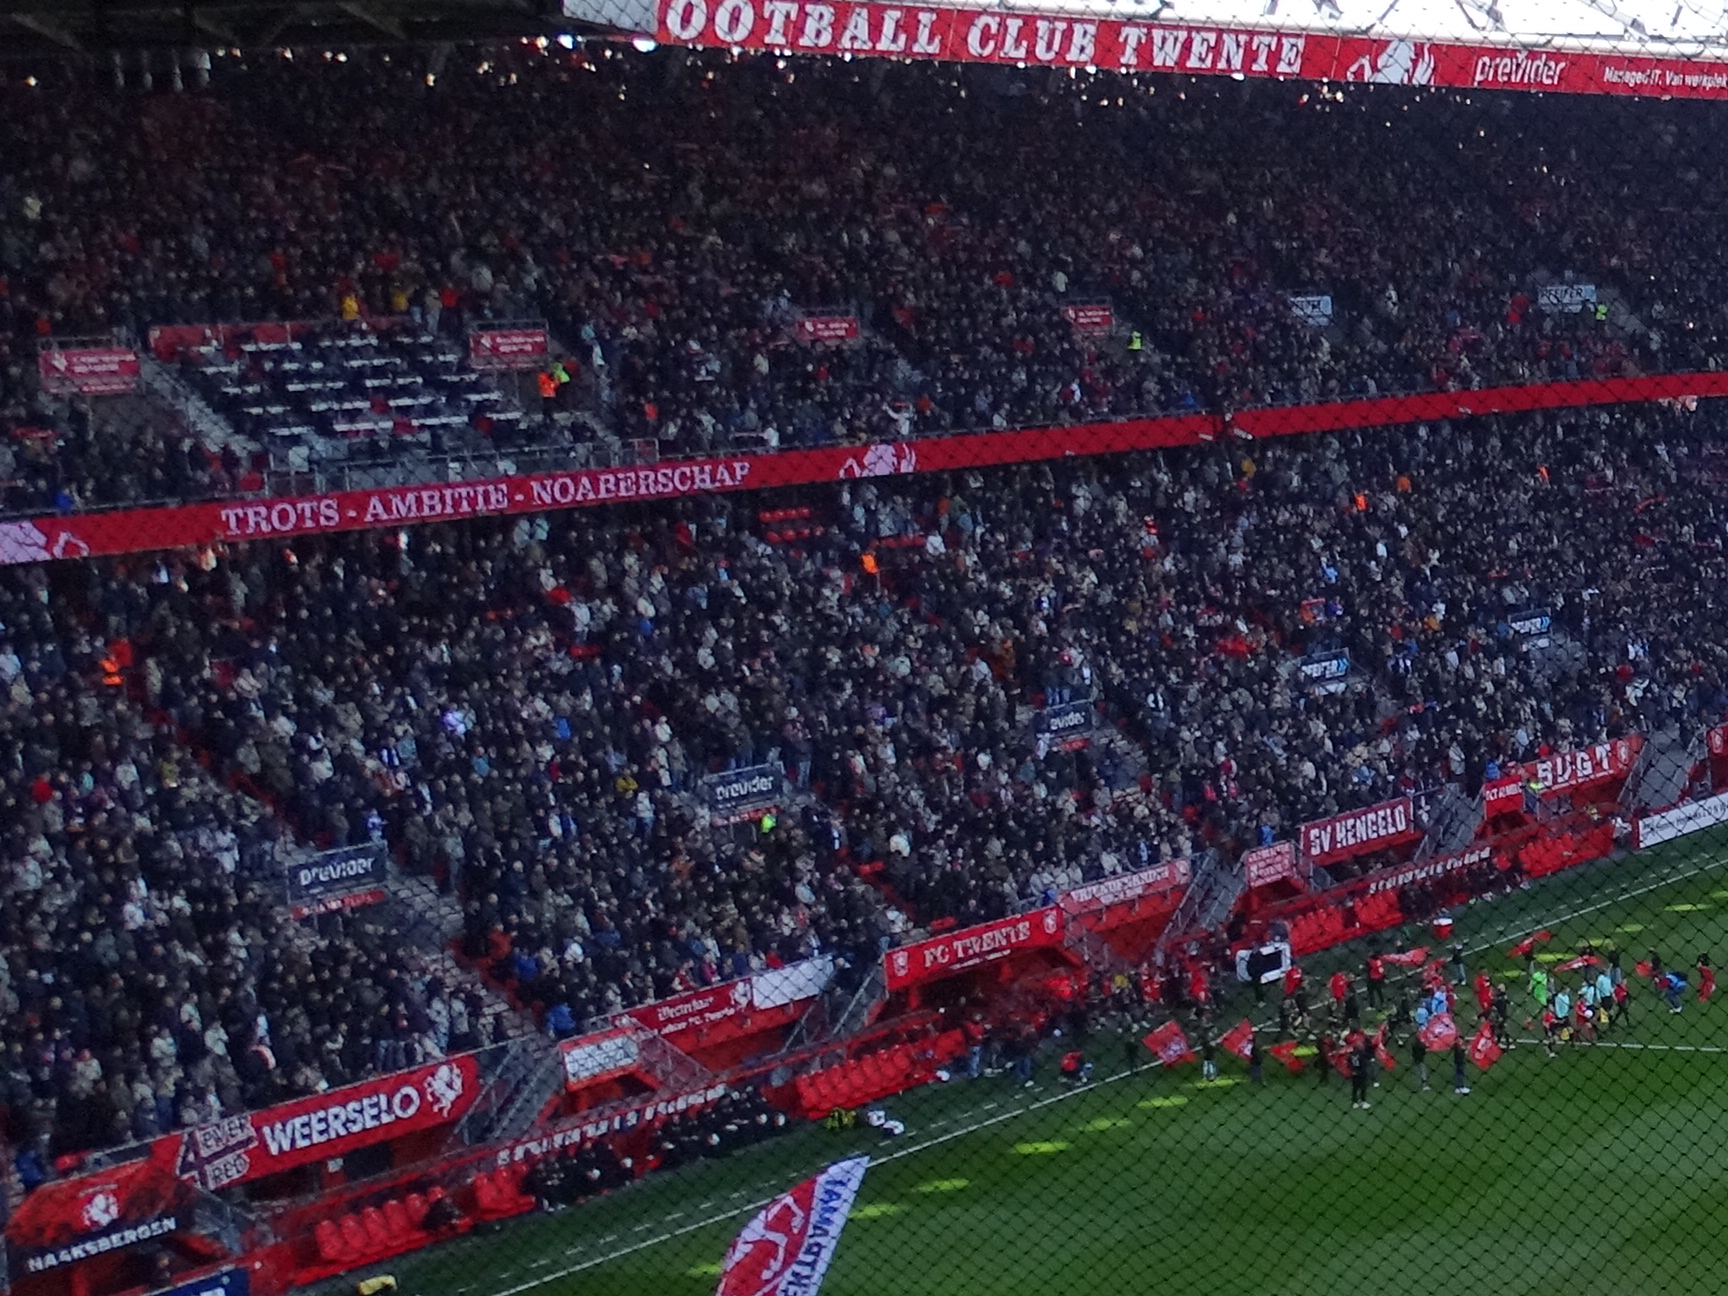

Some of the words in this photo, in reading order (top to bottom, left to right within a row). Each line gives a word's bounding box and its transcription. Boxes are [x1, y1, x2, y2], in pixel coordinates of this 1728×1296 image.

[967, 15, 1097, 61] CLUB
[1119, 26, 1305, 73] TWENTE
[221, 497, 340, 536] TROTS
[364, 482, 508, 523] AMBITIE
[530, 461, 751, 506] NOABERSCHAP
[1310, 824, 1331, 857] SV
[1336, 805, 1406, 847] HENGELO
[924, 944, 950, 969] FC
[953, 921, 1031, 959] TWENTE
[261, 1086, 421, 1156] WEERSELO
